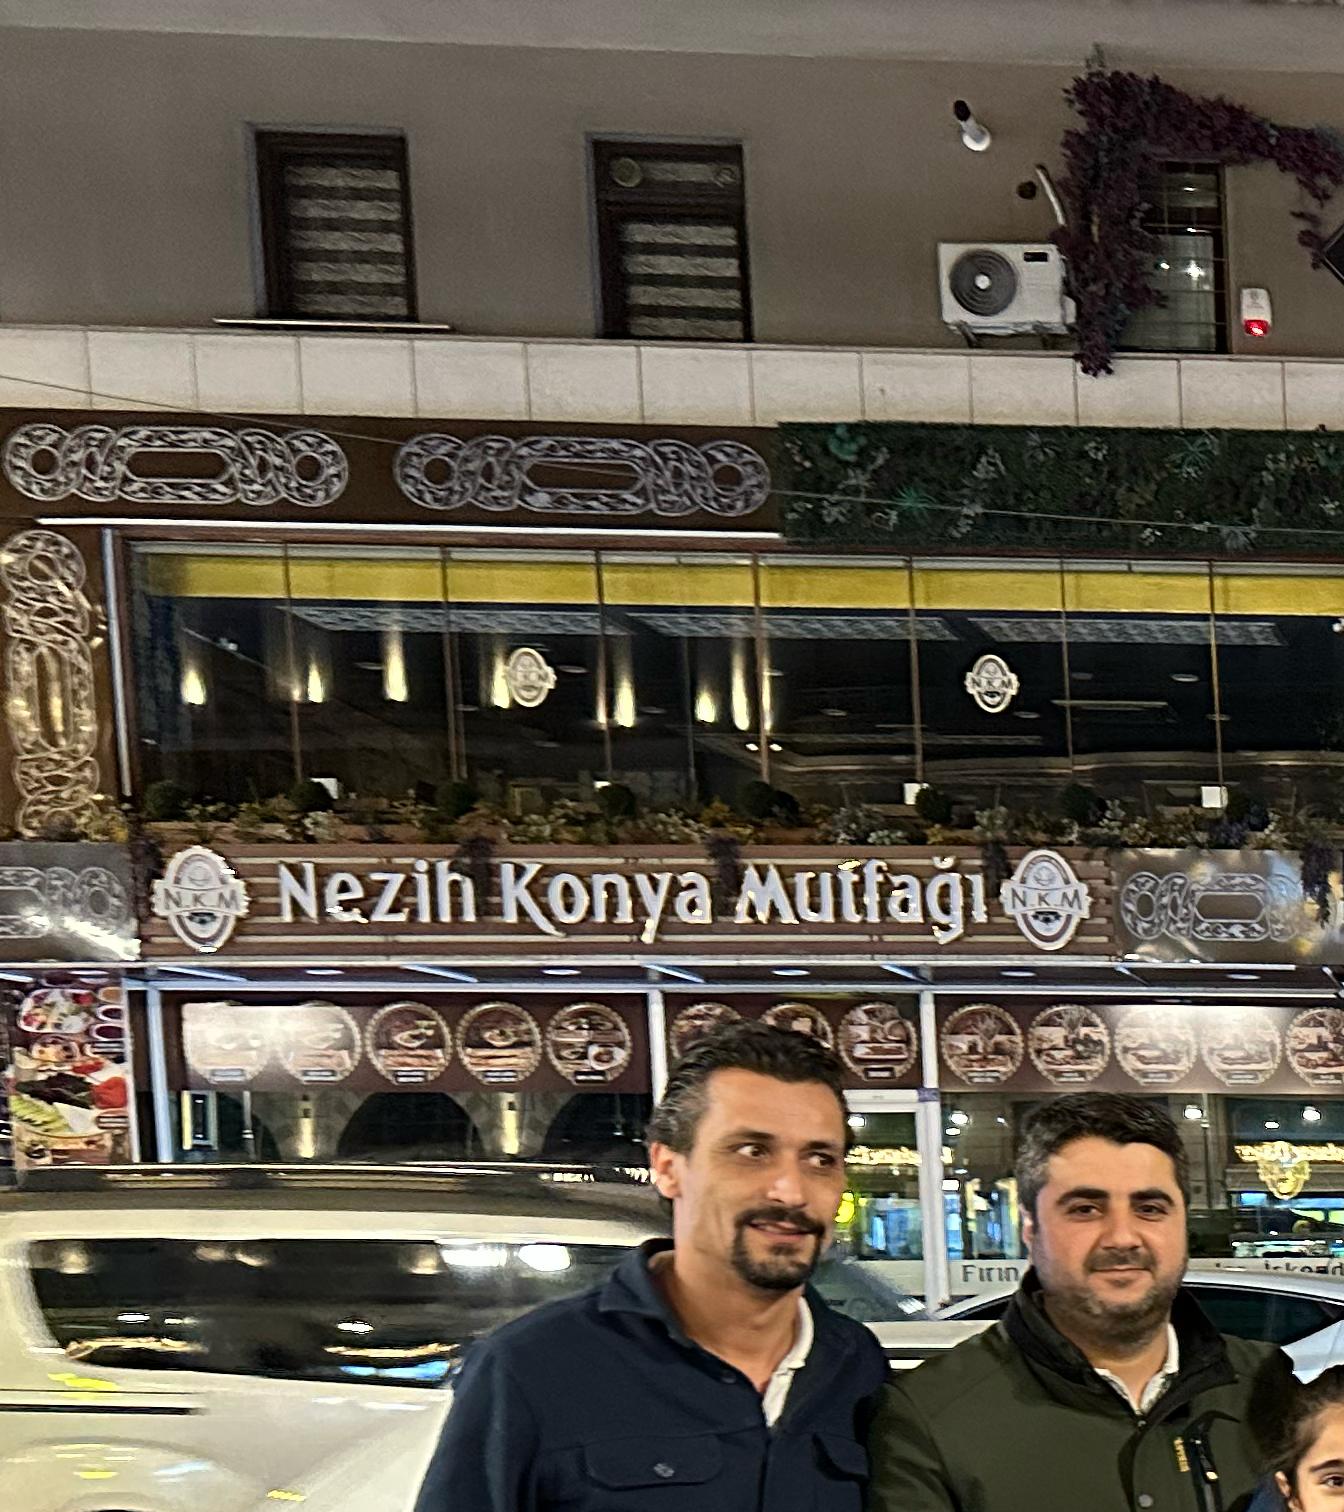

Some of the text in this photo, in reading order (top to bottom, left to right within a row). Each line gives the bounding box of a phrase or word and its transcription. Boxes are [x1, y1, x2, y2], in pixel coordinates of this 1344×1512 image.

[278, 857, 988, 945] Nezih Konya Mutfağı
[962, 1264, 1020, 1282] Fırın
